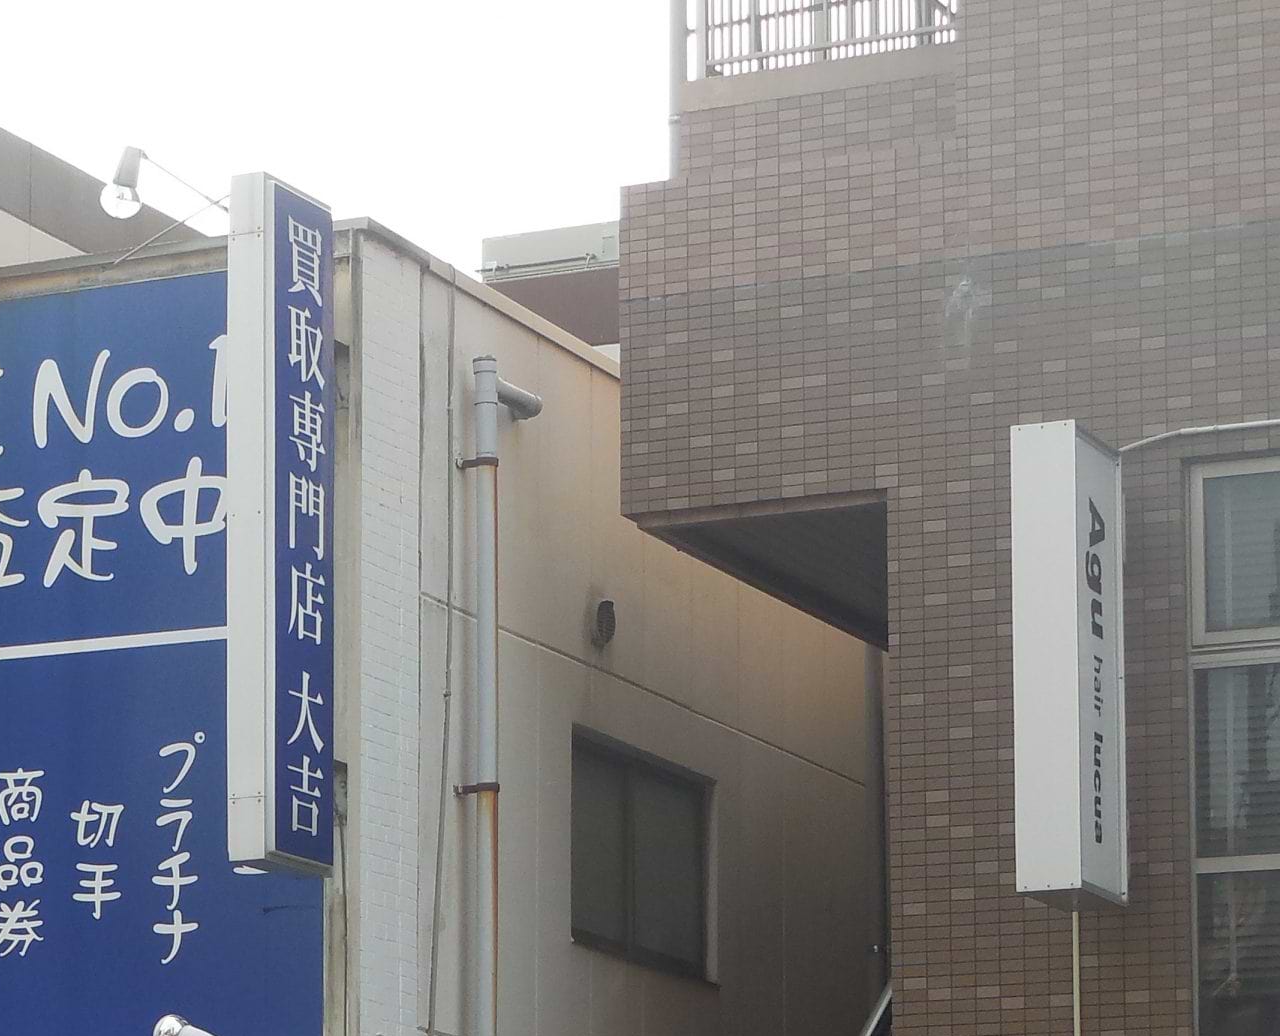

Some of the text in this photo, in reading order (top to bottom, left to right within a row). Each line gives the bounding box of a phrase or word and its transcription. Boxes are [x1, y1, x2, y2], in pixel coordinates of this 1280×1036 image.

[1086, 496, 1106, 641] Agu
[1093, 654, 1103, 718] hair
[70, 800, 125, 919] 切手
[152, 731, 206, 965] プラチナ
